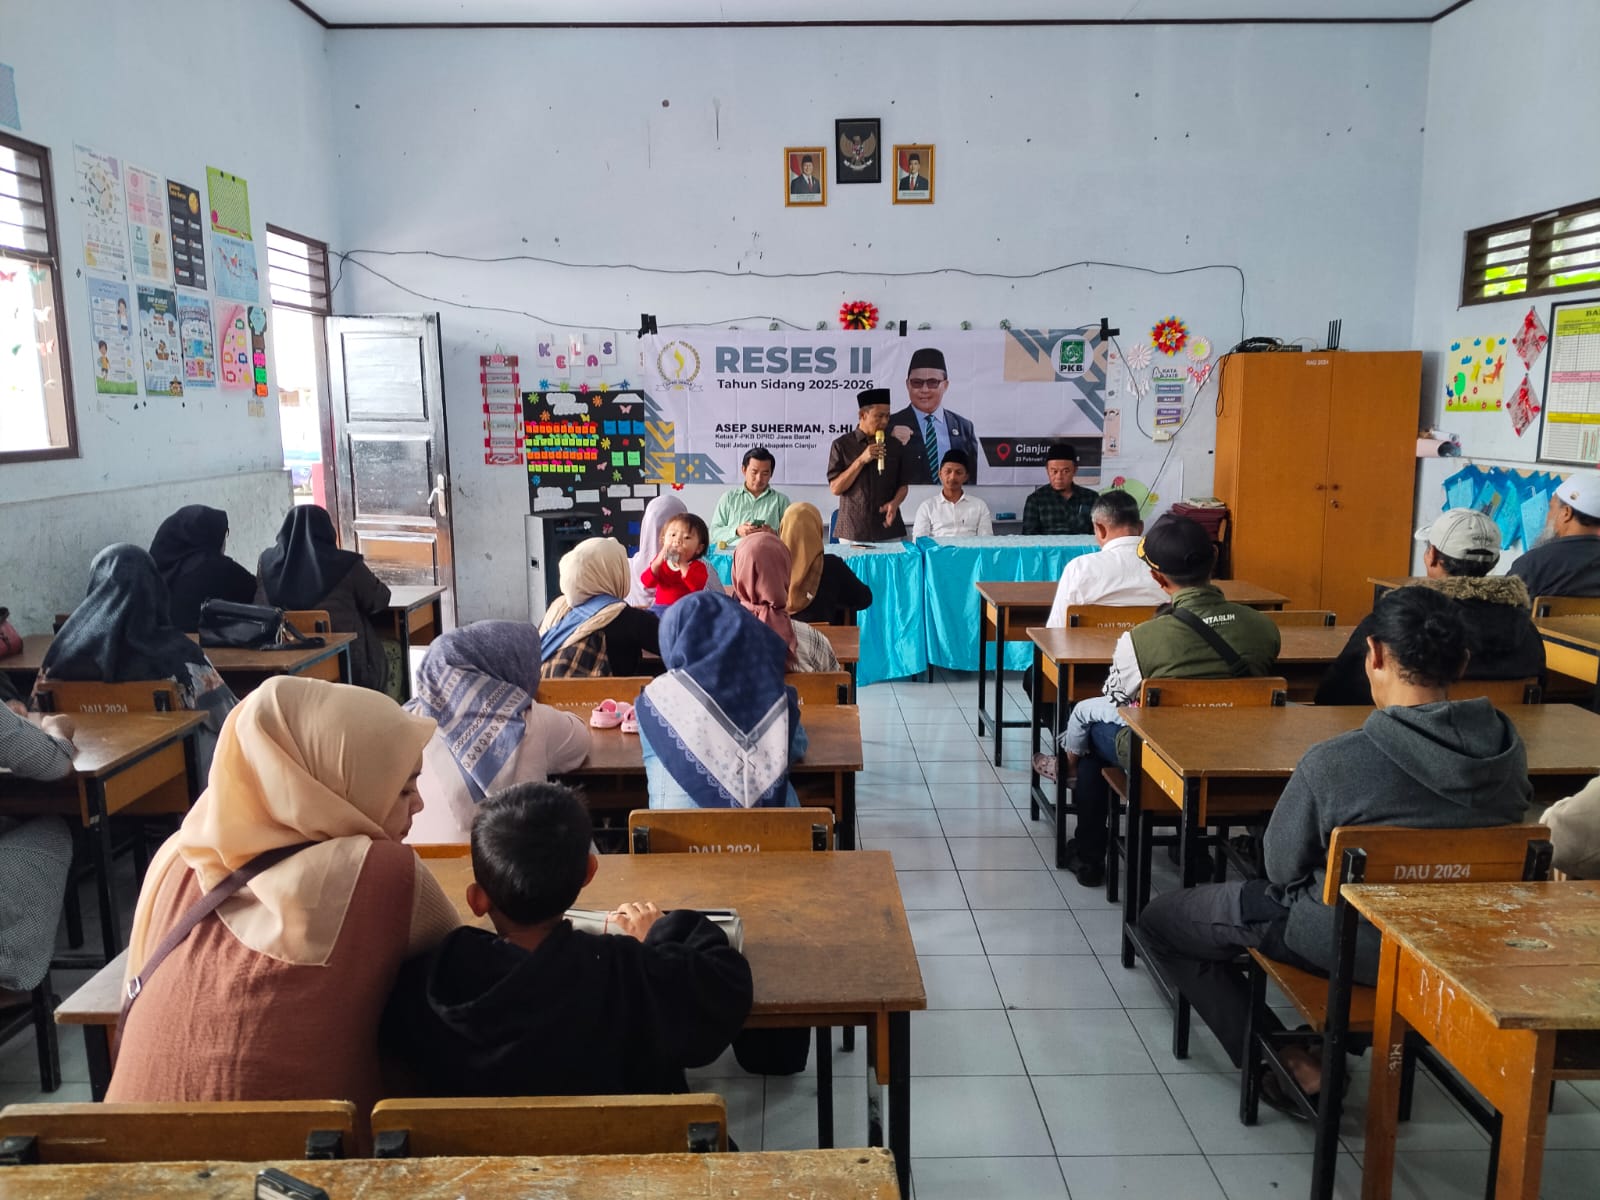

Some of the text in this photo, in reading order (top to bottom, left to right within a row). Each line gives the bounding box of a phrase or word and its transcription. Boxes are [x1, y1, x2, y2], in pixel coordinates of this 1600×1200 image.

[716, 346, 871, 374] RESES II
[1060, 364, 1083, 372] PKB
[717, 379, 873, 391] Tahun Sidang 2025-2026
[715, 424, 747, 433] ASEP
[751, 424, 825, 435] SUHERMAN,
[794, 442, 817, 450] Cianjur
[1016, 444, 1051, 455] Cianjur
[1394, 864, 1471, 880] DAU 2024
